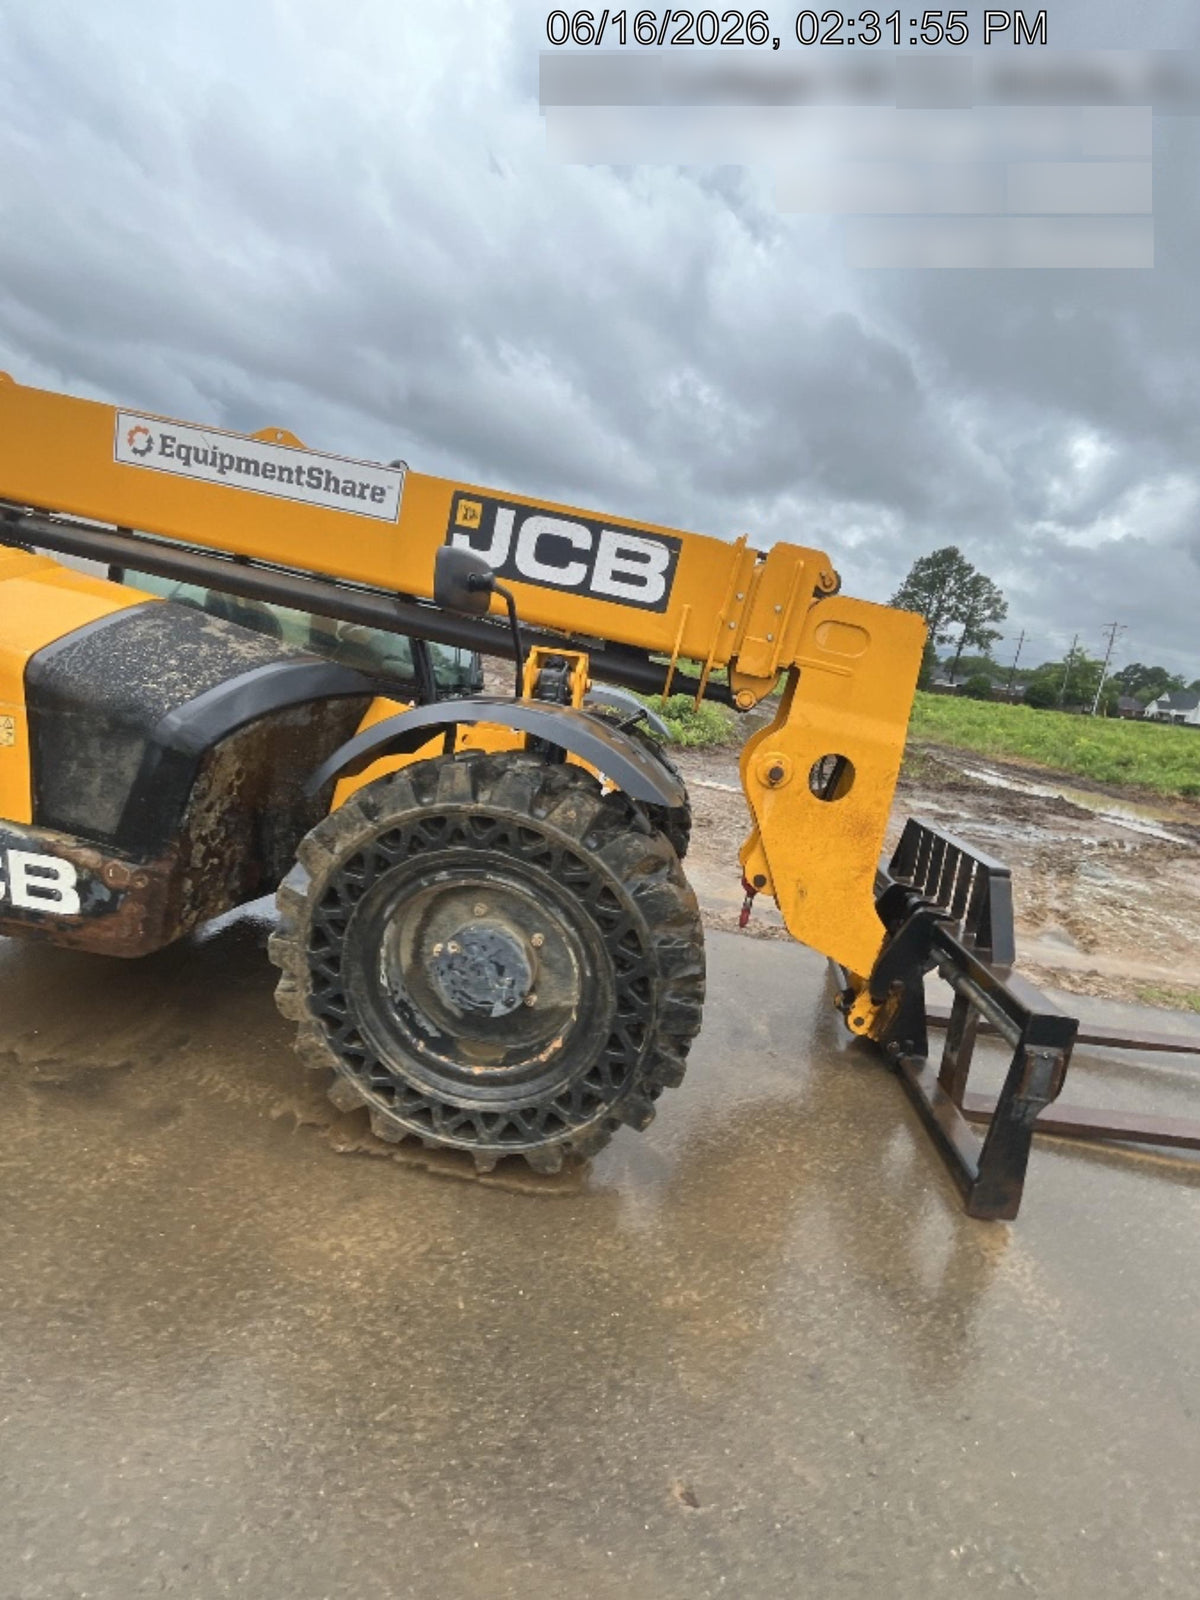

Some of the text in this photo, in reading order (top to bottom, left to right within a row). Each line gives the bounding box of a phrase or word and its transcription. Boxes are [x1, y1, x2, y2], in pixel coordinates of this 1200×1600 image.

[158, 433, 386, 504] EquipmentShare
[452, 507, 671, 604] JCB
[0, 848, 81, 915] B
